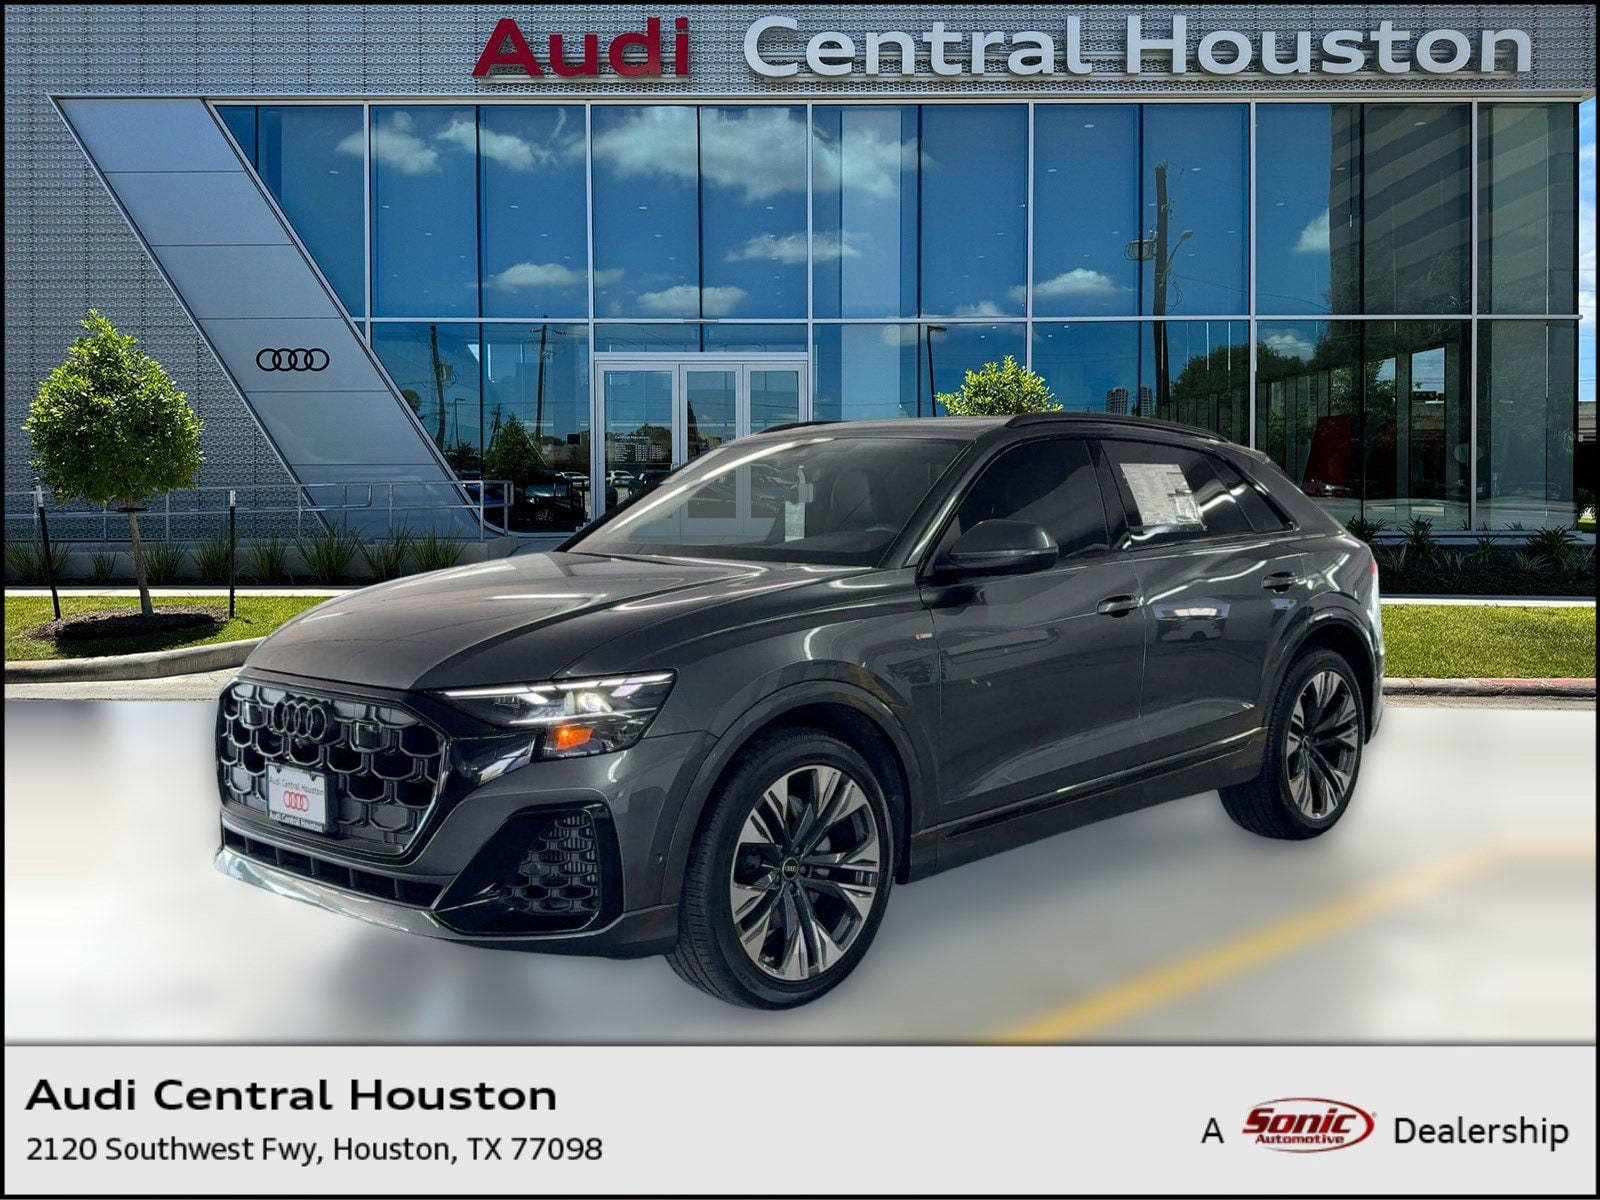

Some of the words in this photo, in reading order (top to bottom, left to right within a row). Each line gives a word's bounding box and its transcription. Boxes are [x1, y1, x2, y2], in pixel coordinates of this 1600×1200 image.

[472, 17, 690, 78] Audi
[743, 16, 1092, 77] Central
[1126, 15, 1533, 76] Houston
